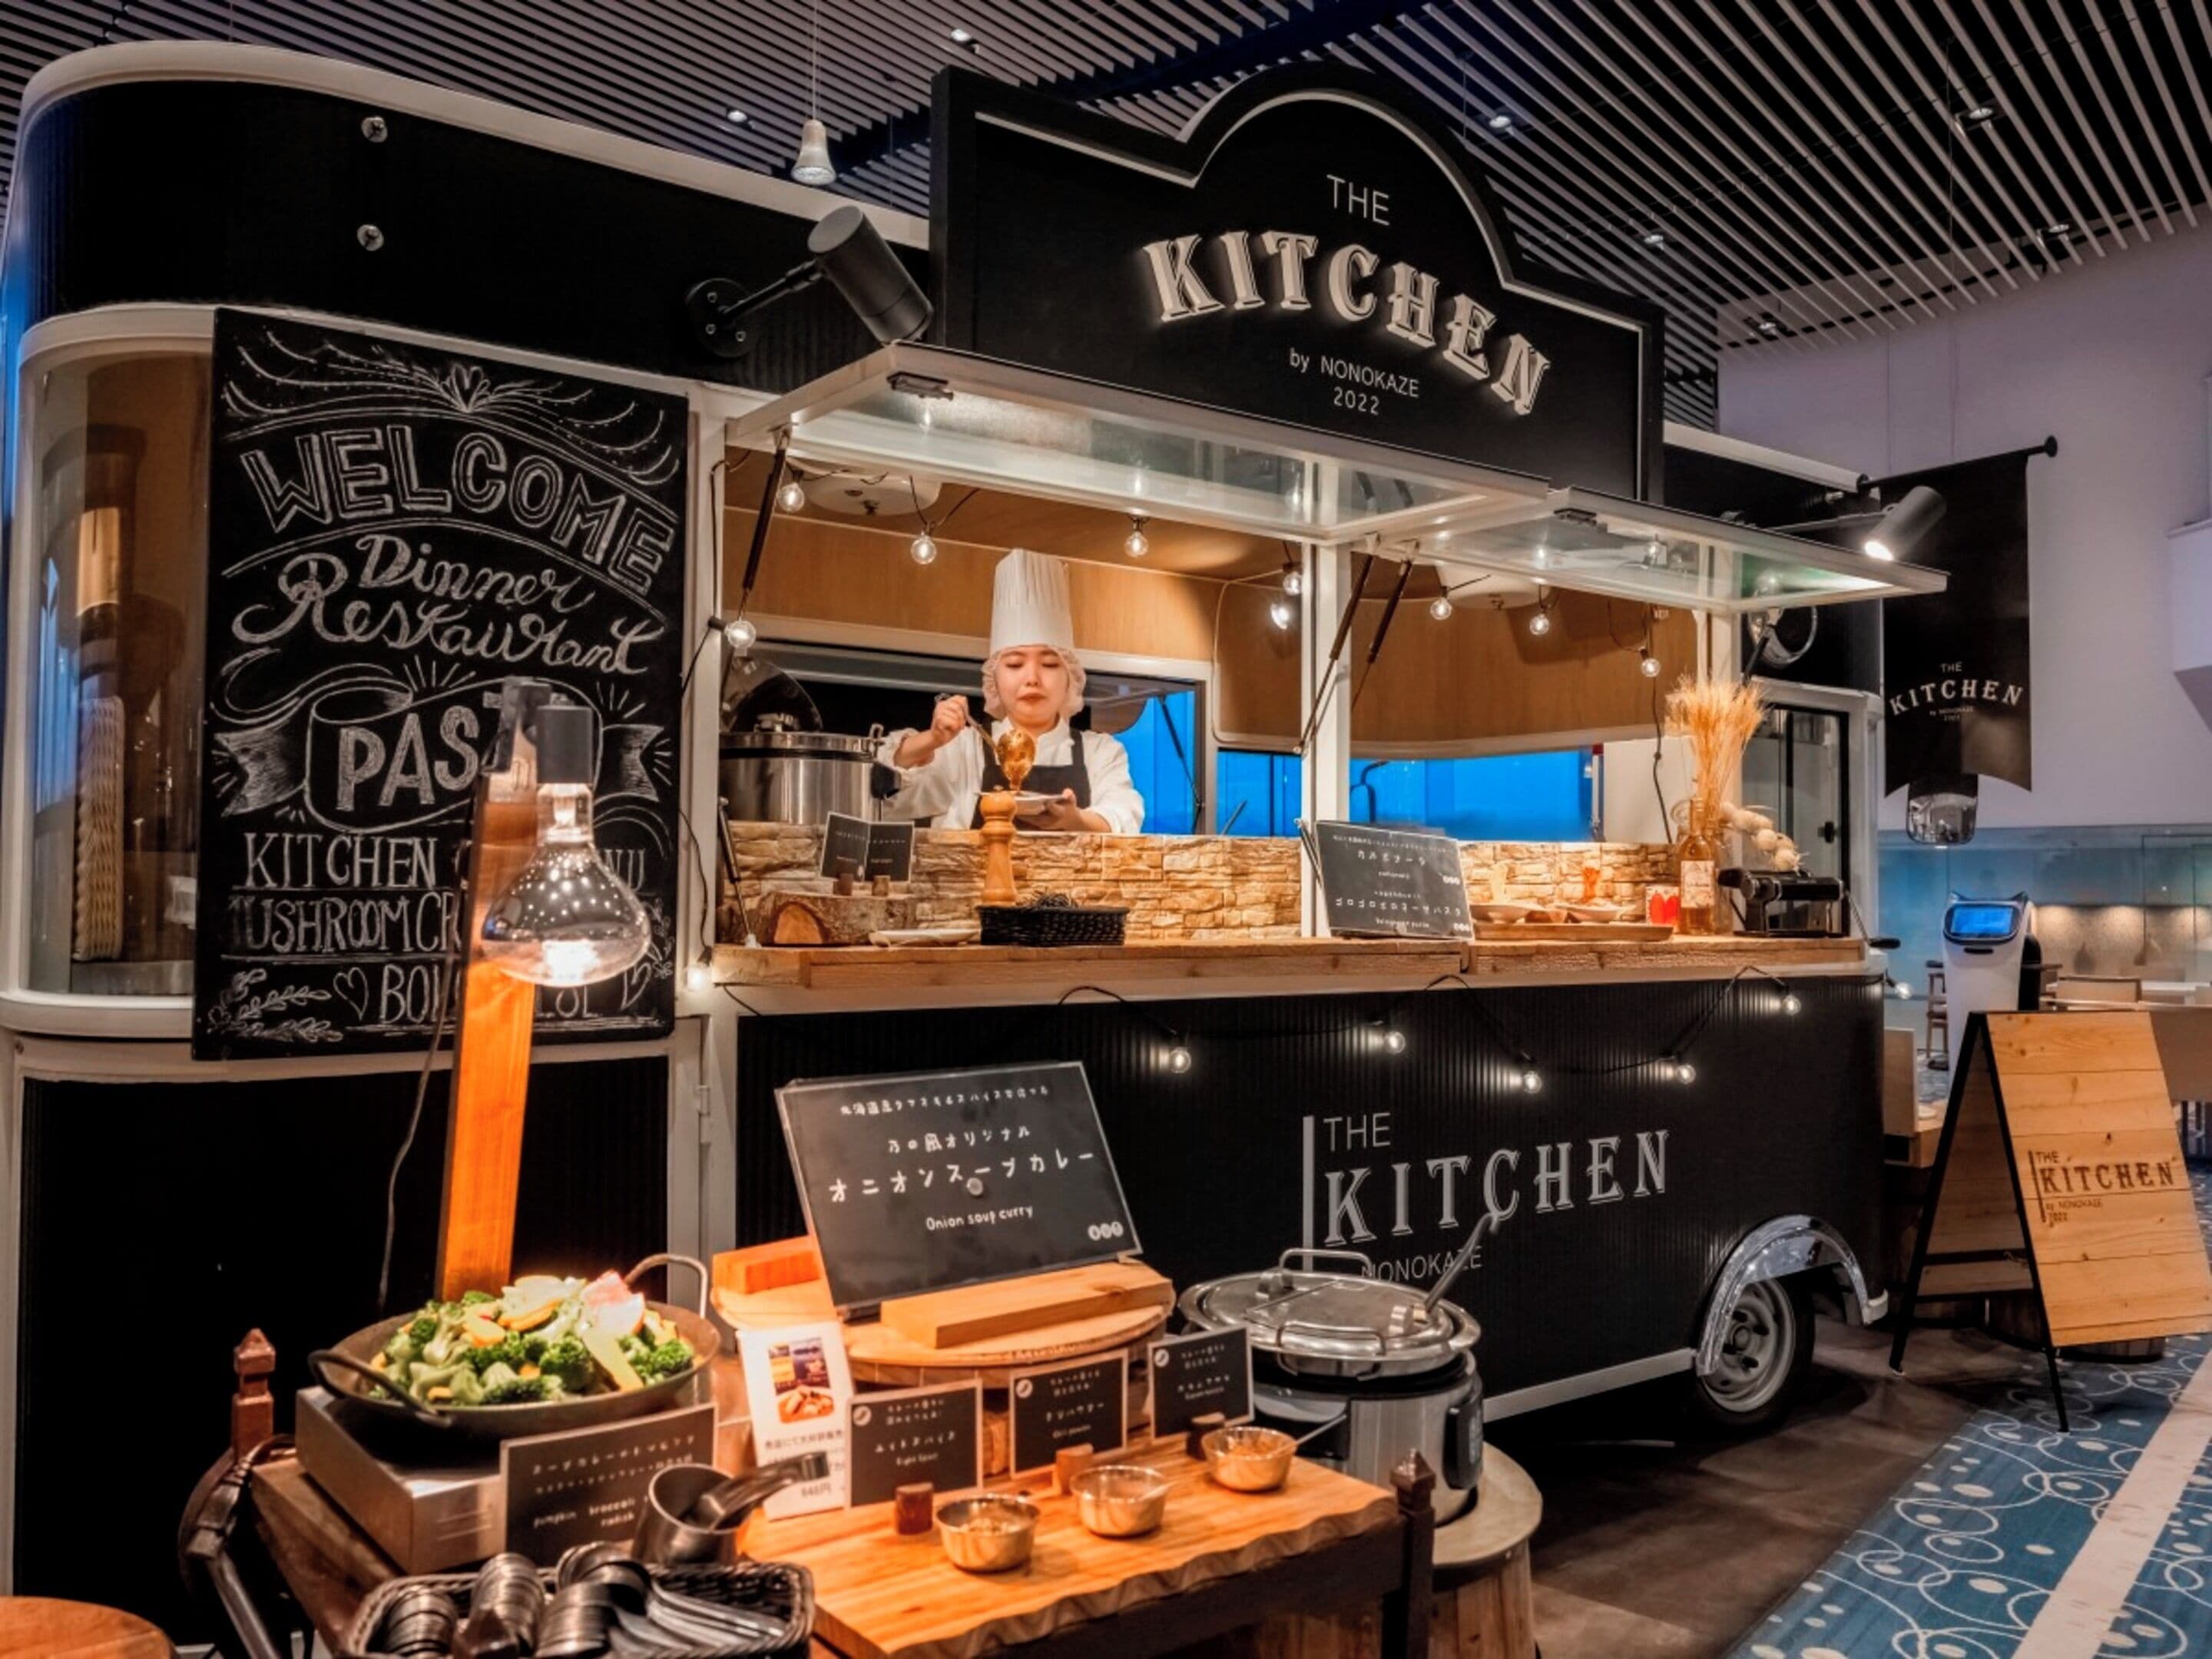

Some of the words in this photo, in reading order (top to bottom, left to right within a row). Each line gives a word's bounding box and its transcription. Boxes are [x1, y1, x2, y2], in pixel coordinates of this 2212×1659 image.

[1326, 174, 1389, 226] THE
[1142, 230, 1551, 416] KITCHEN
[1290, 347, 1310, 374] by
[1321, 356, 1419, 399] NONOKAZE
[1333, 387, 1380, 416] 2022
[240, 425, 676, 595] WELCOME
[355, 534, 596, 613] Dinner
[232, 552, 665, 675] Restaurant
[1940, 662, 1962, 674] THE
[1889, 679, 2024, 716] KITCHEN
[336, 691, 575, 812] PAS
[243, 833, 438, 888] KITCHEN
[1323, 1112, 1391, 1151] THE
[2035, 1151, 2060, 1164] THE
[829, 1149, 1094, 1203] オニオンスープカレー
[1323, 1129, 1670, 1247] KITCHEN
[2039, 1162, 2174, 1194] KITCHEN
[926, 1215, 965, 1230] Onion
[967, 1210, 996, 1225] soup
[998, 1205, 1033, 1220] curry
